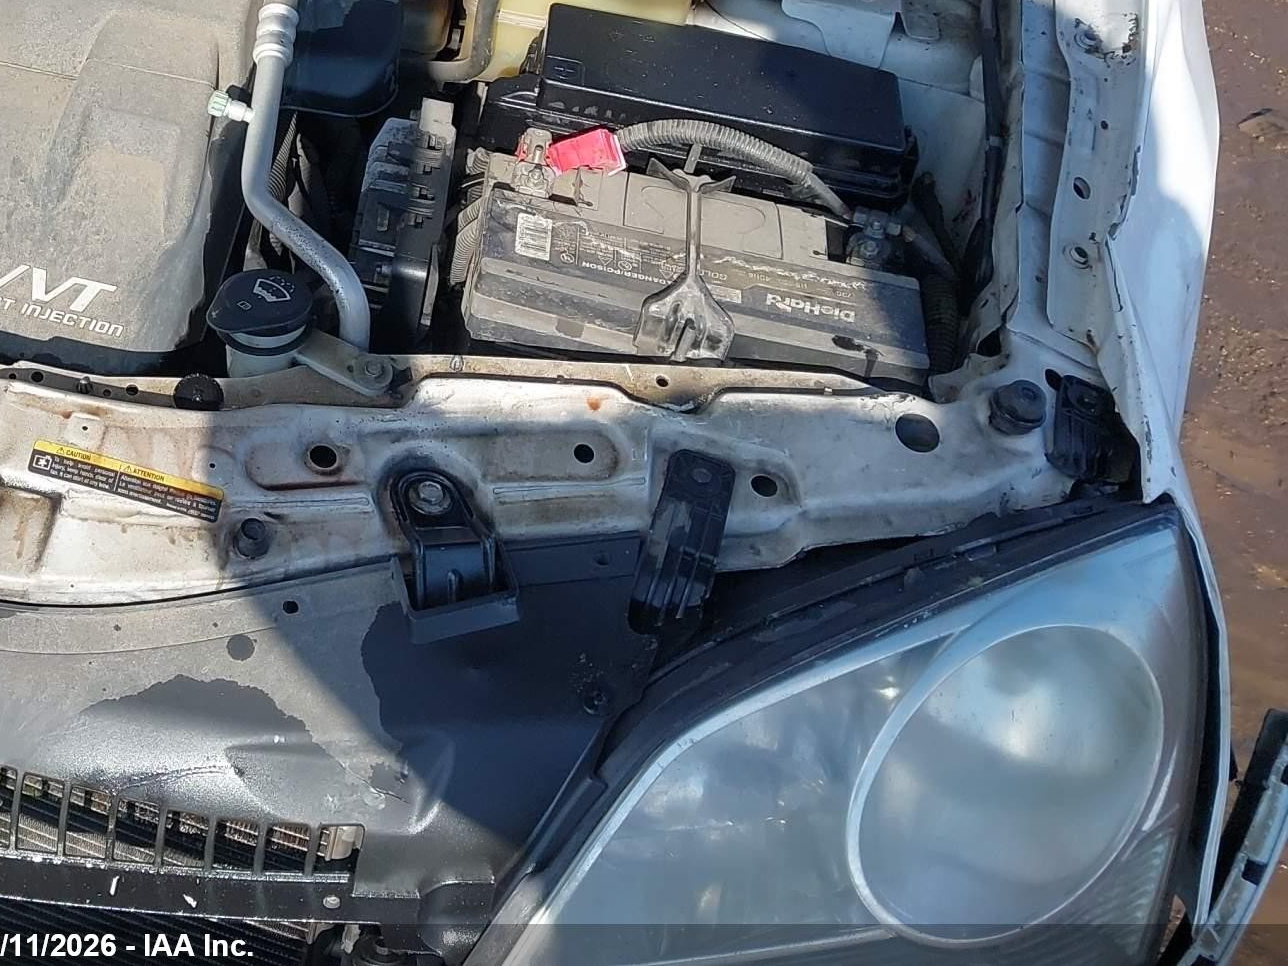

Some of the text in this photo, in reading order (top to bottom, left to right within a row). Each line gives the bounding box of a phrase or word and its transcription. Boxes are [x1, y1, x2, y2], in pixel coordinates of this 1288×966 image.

[766, 293, 856, 323] DieHard
[21, 303, 124, 338] INJECTION
[66, 449, 91, 461] CAUTION
[133, 469, 165, 482] ATTENTION
